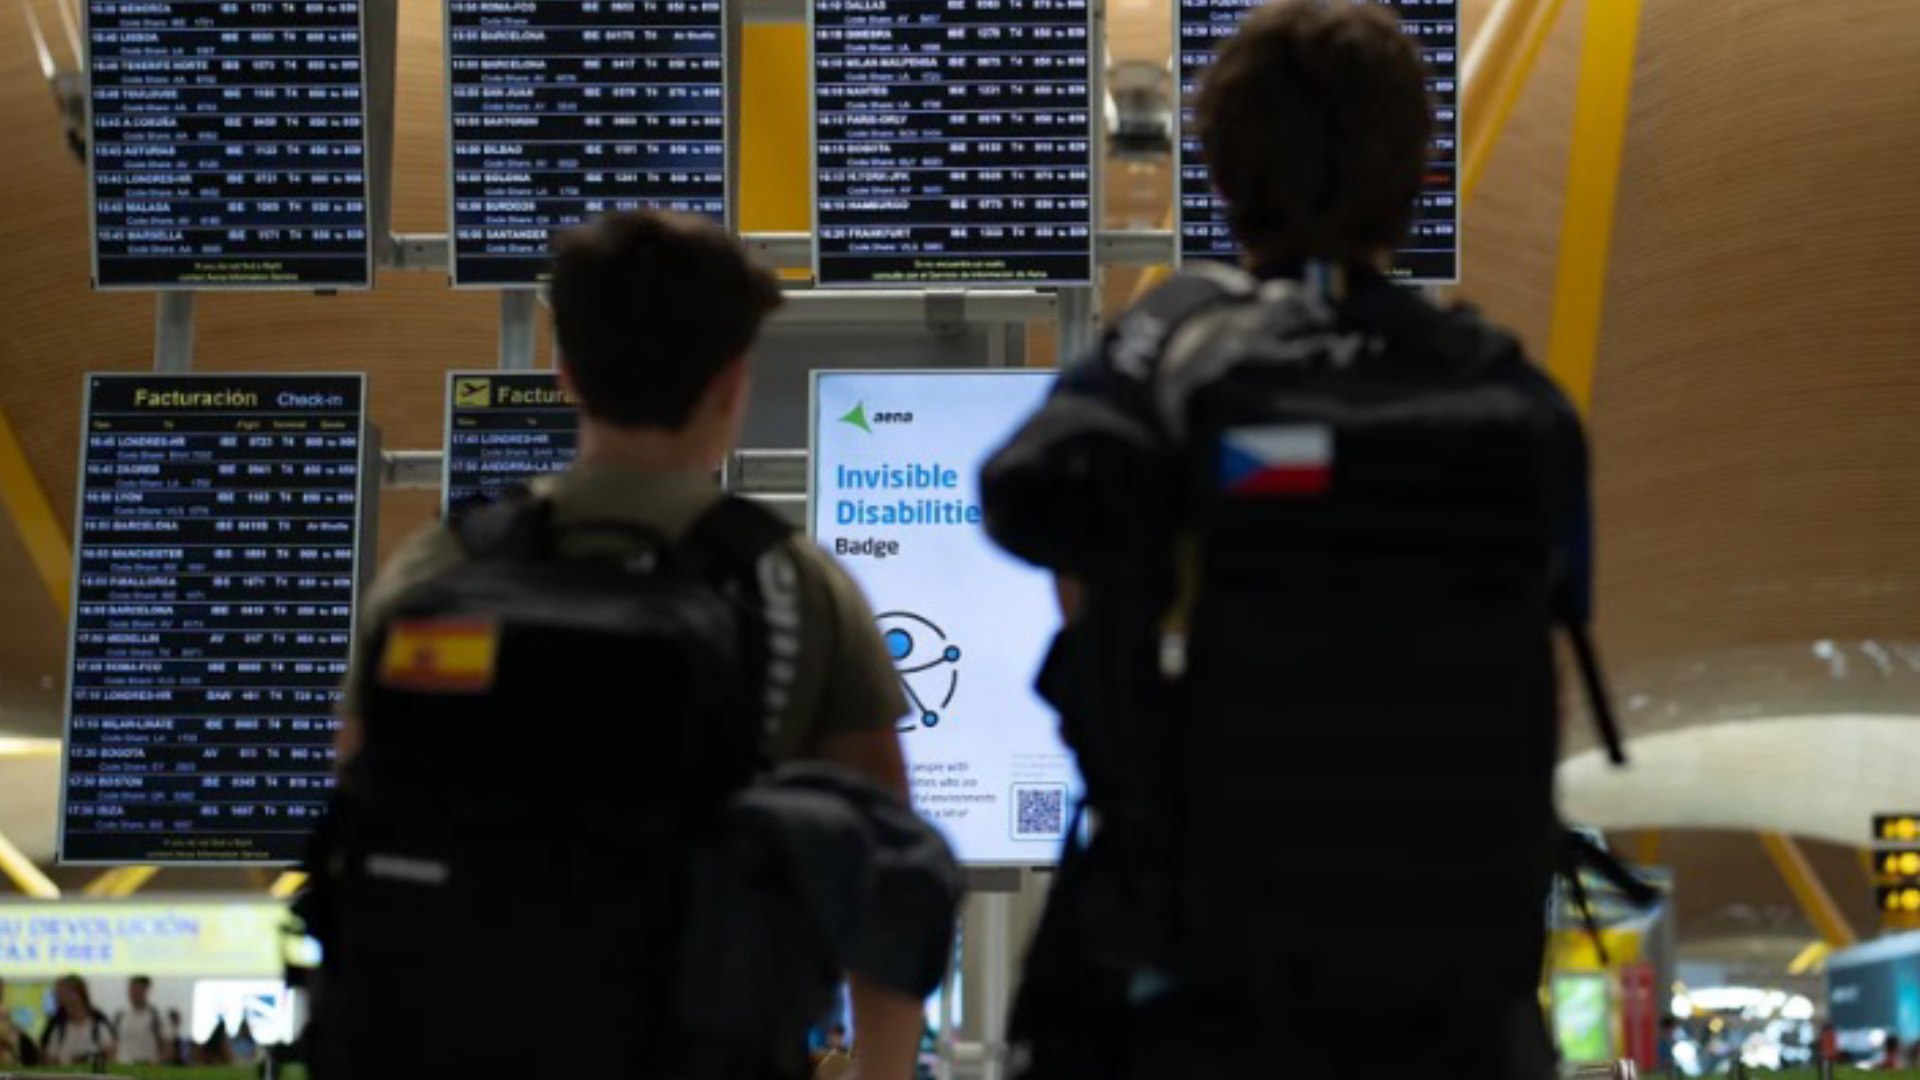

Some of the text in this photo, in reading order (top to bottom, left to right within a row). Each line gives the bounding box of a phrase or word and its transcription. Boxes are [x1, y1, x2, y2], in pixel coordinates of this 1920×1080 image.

[481, 30, 545, 40] BARCELONA
[481, 58, 546, 69] BARCELONA
[486, 228, 548, 239] SANTANDER
[134, 388, 343, 407] Facturación Check-in
[873, 411, 913, 424] aena
[837, 464, 958, 489] Invisible
[836, 500, 982, 526] Disabilitie
[836, 538, 899, 558] Badge
